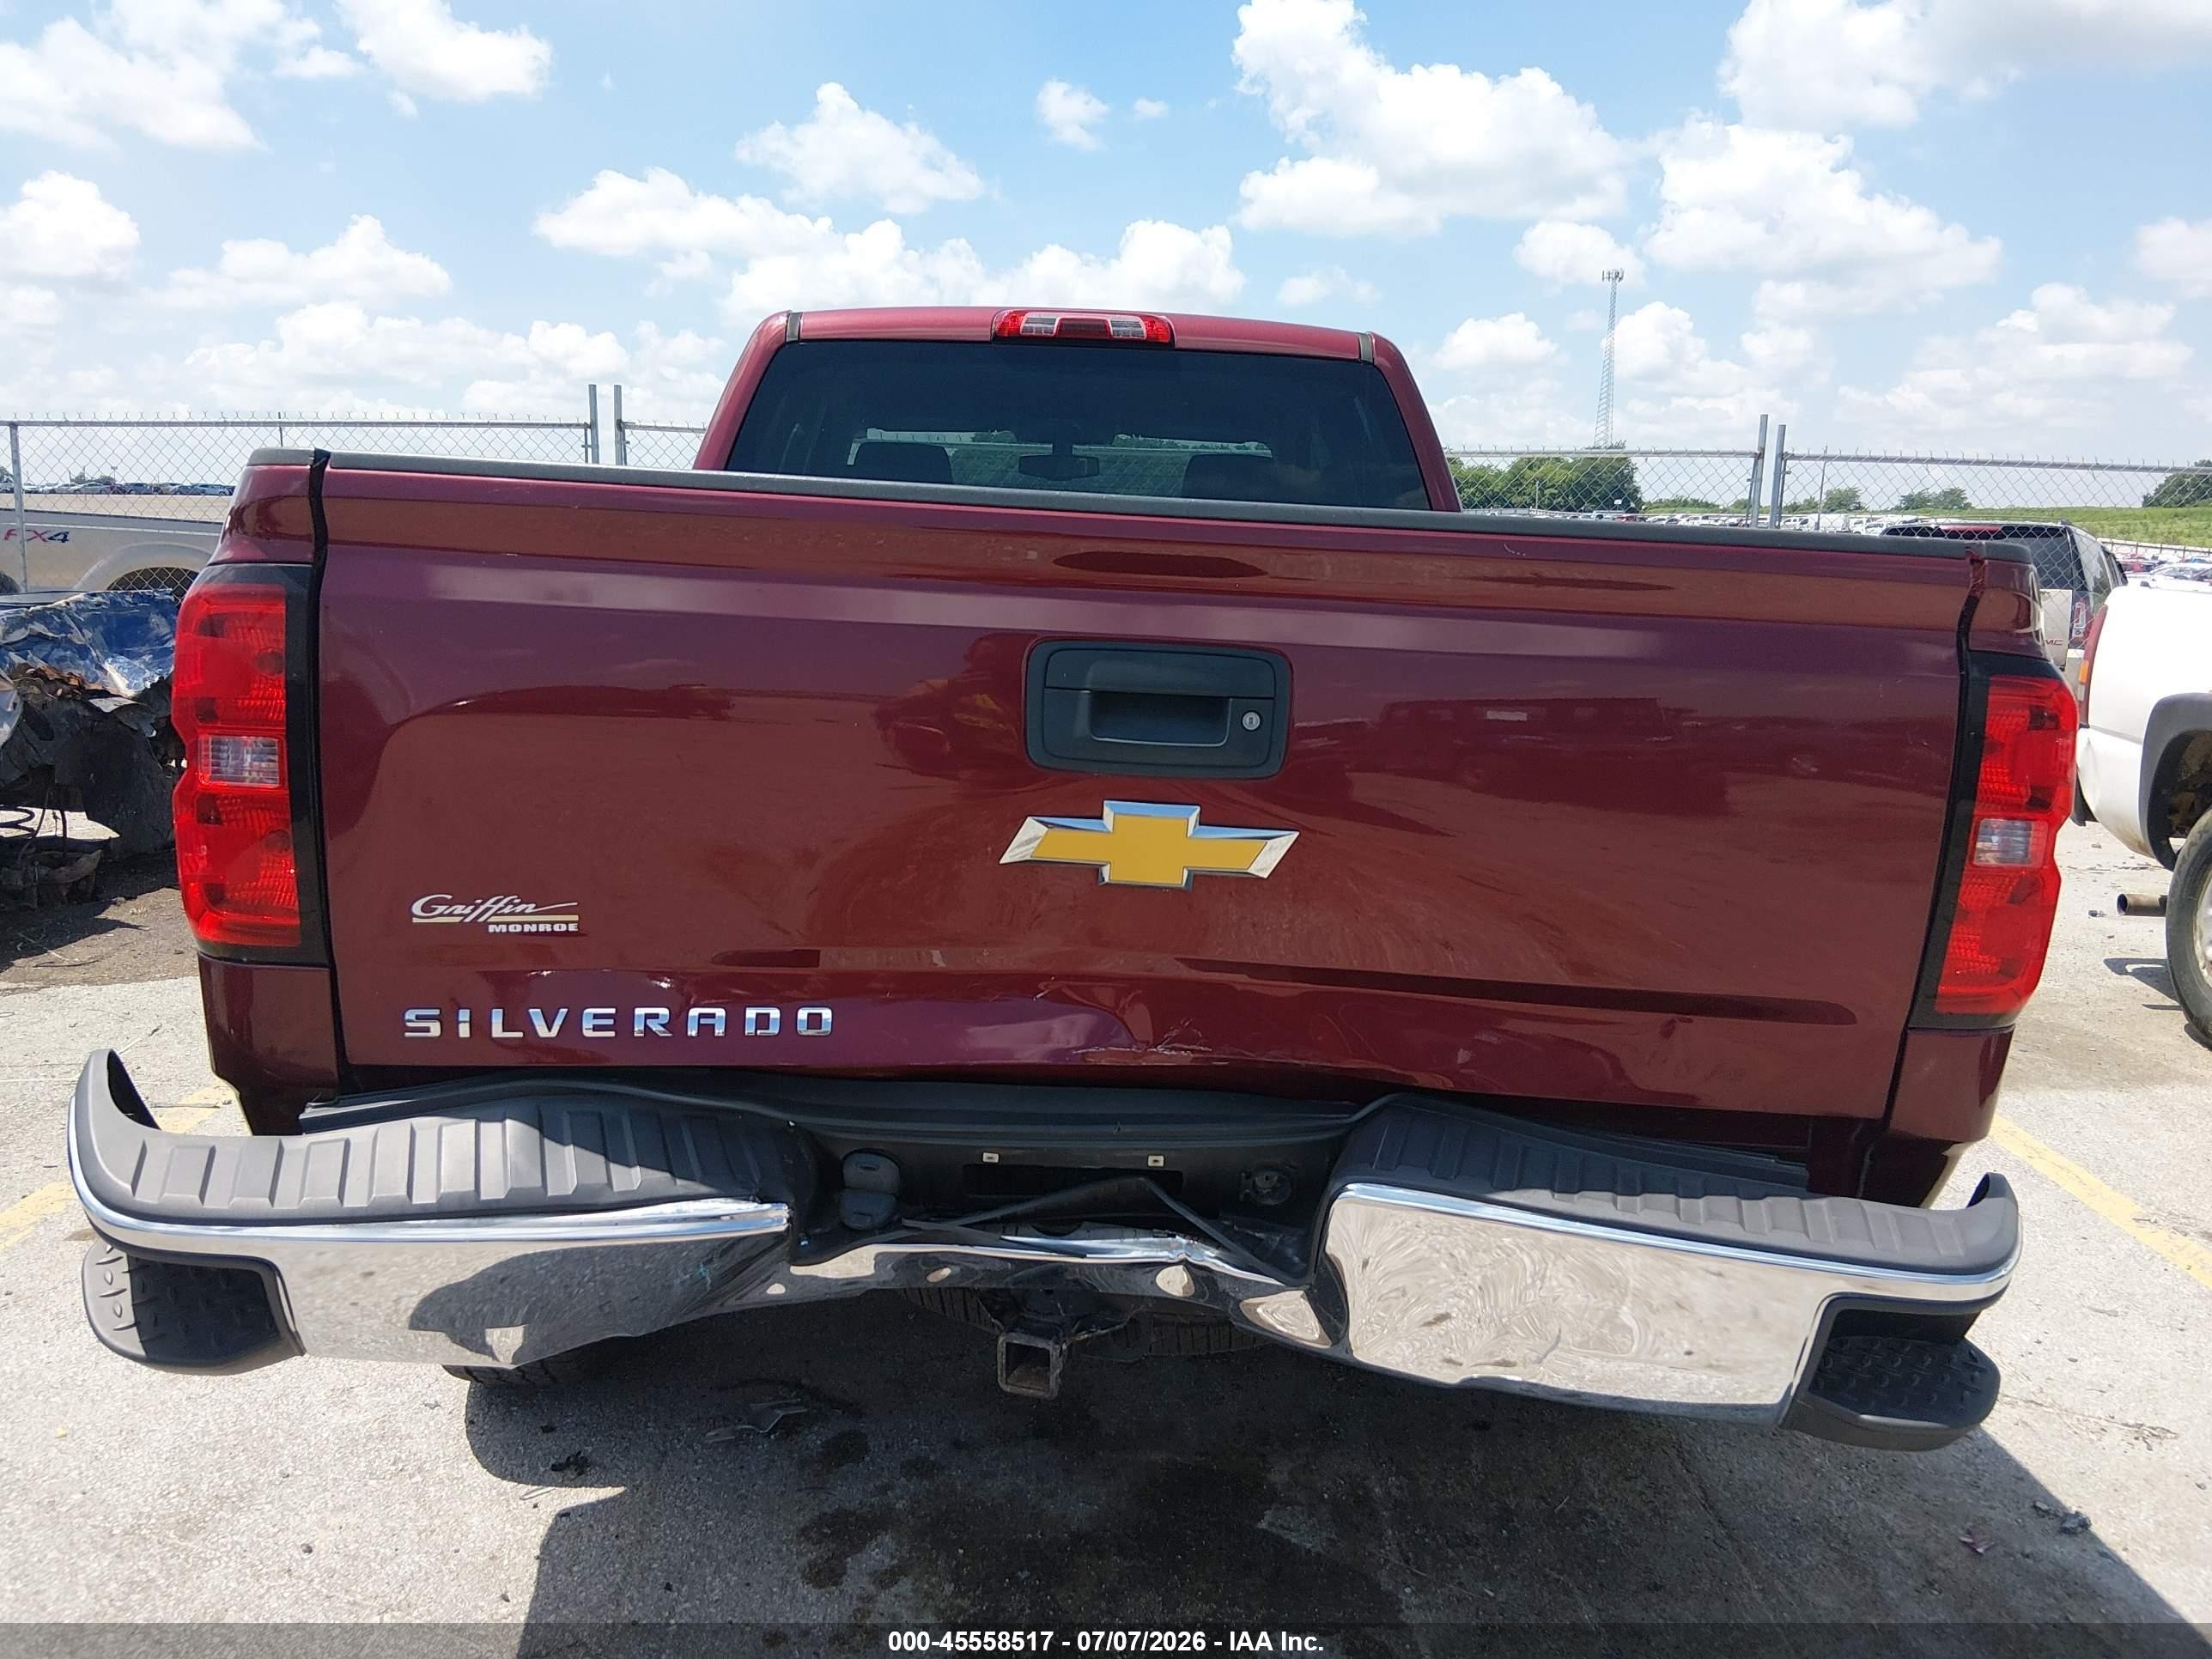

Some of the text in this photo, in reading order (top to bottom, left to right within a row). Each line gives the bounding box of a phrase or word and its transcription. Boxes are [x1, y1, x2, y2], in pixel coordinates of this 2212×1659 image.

[4, 528, 70, 544] FX4
[411, 894, 579, 922] Griffin
[488, 922, 579, 933] MONROE
[404, 1007, 834, 1038] SILVERADO
